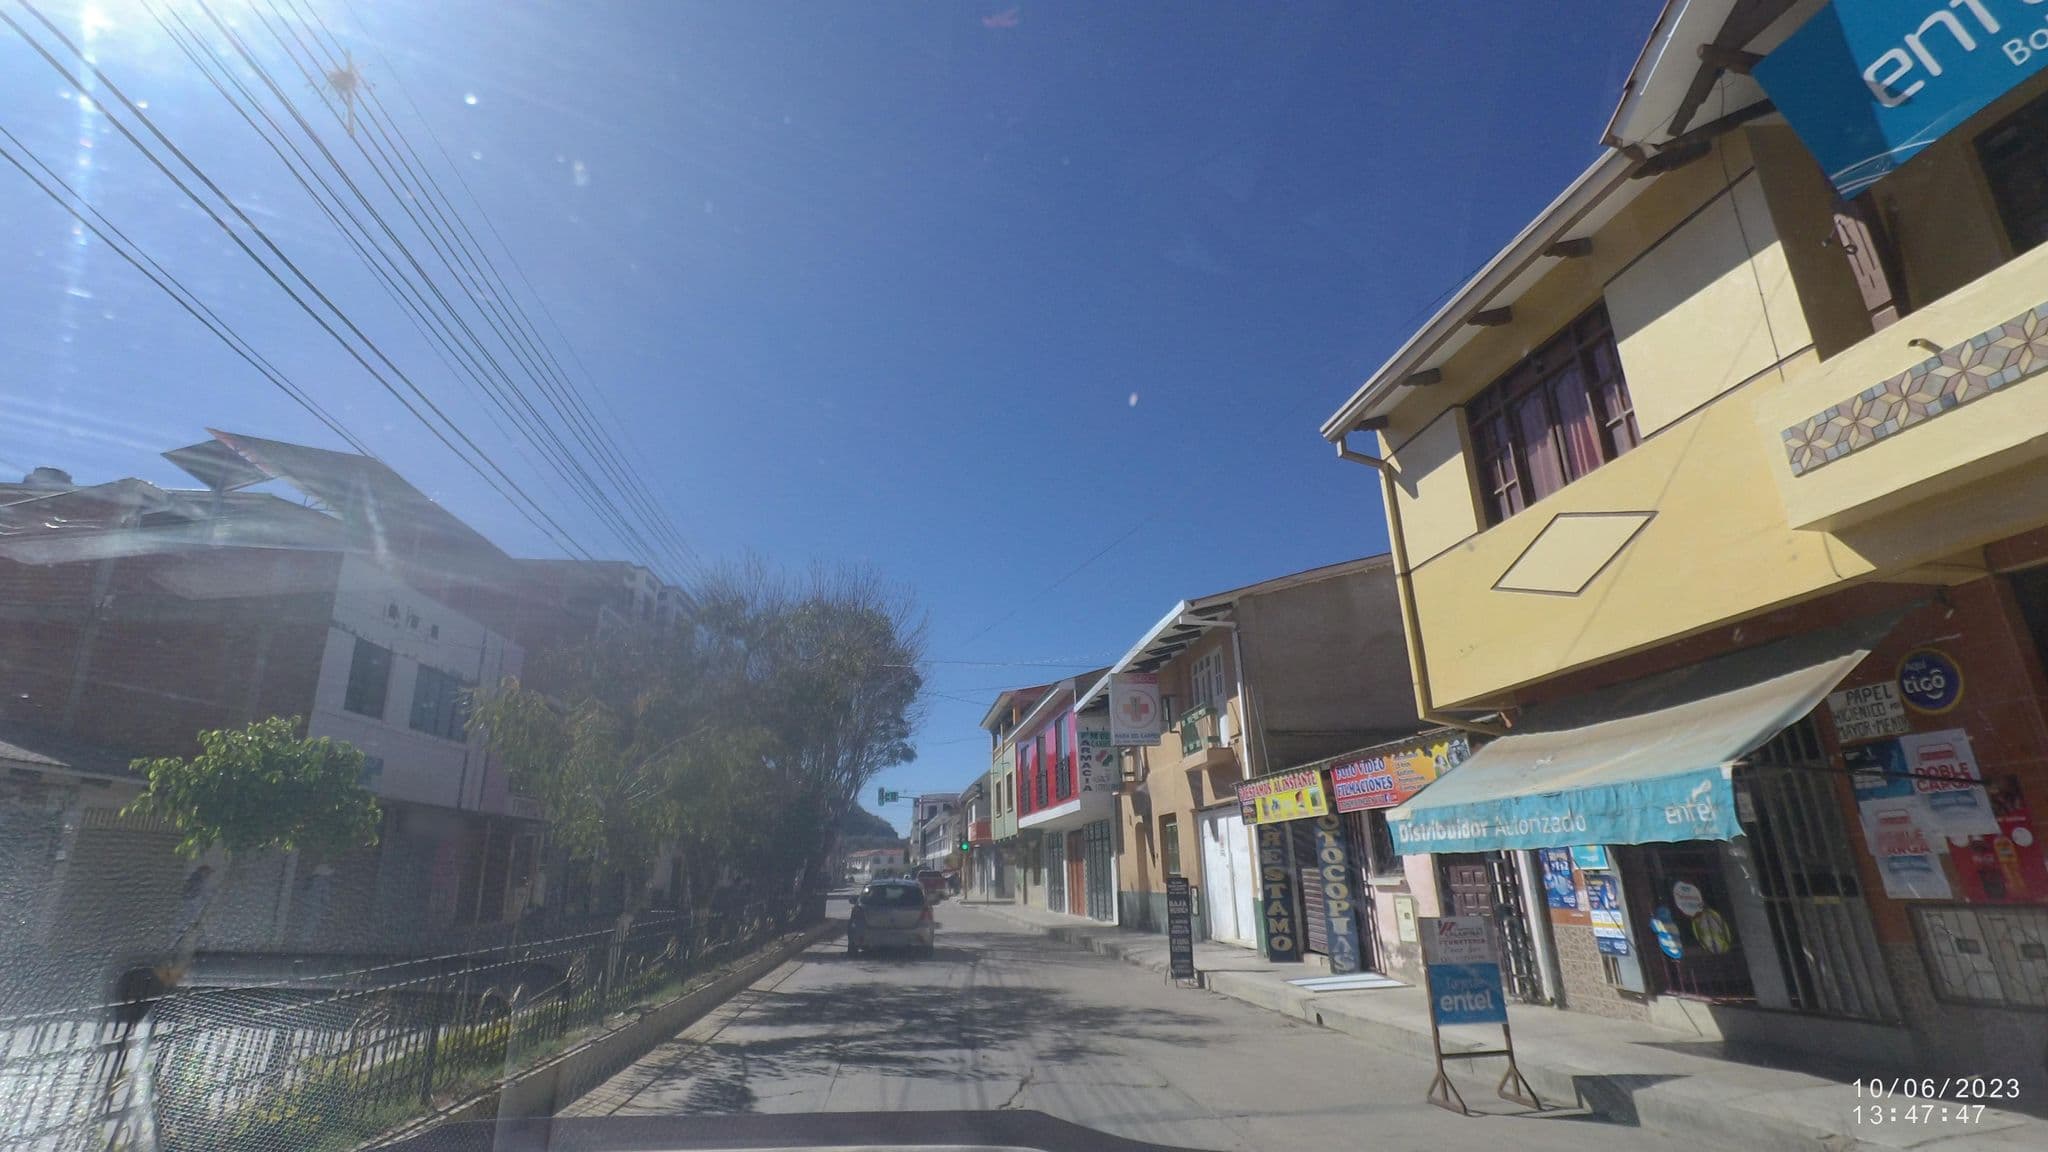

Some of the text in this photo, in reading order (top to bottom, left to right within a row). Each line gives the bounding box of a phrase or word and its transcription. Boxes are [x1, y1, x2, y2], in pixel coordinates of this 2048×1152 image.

[1863, 0, 2043, 108] ent
[1846, 684, 1892, 706] PAPEL
[1080, 732, 1093, 792] FARMACIA
[1399, 820, 1489, 843] Distribuidor
[1260, 824, 1293, 951] RESTAMO
[1440, 989, 1494, 1012] entel
